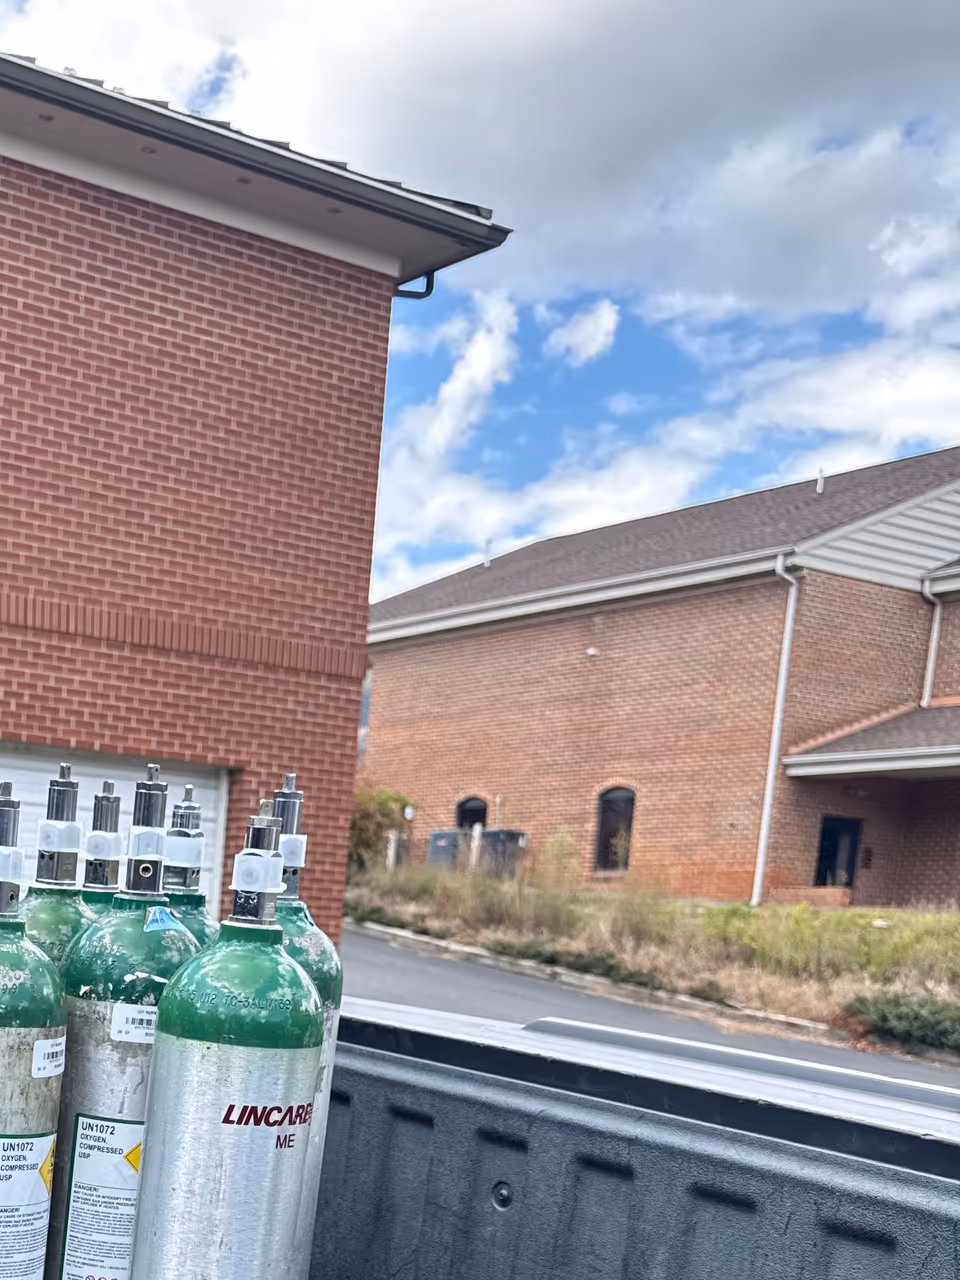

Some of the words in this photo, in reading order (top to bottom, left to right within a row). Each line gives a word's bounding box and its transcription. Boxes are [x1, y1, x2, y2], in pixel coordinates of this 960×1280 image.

[81, 1121, 116, 1135] UN1072
[2, 1142, 34, 1152] UN1072
[275, 1133, 296, 1149] ME
[79, 1142, 124, 1155] COMPRESSED
[0, 1163, 39, 1172] COMPRESSED
